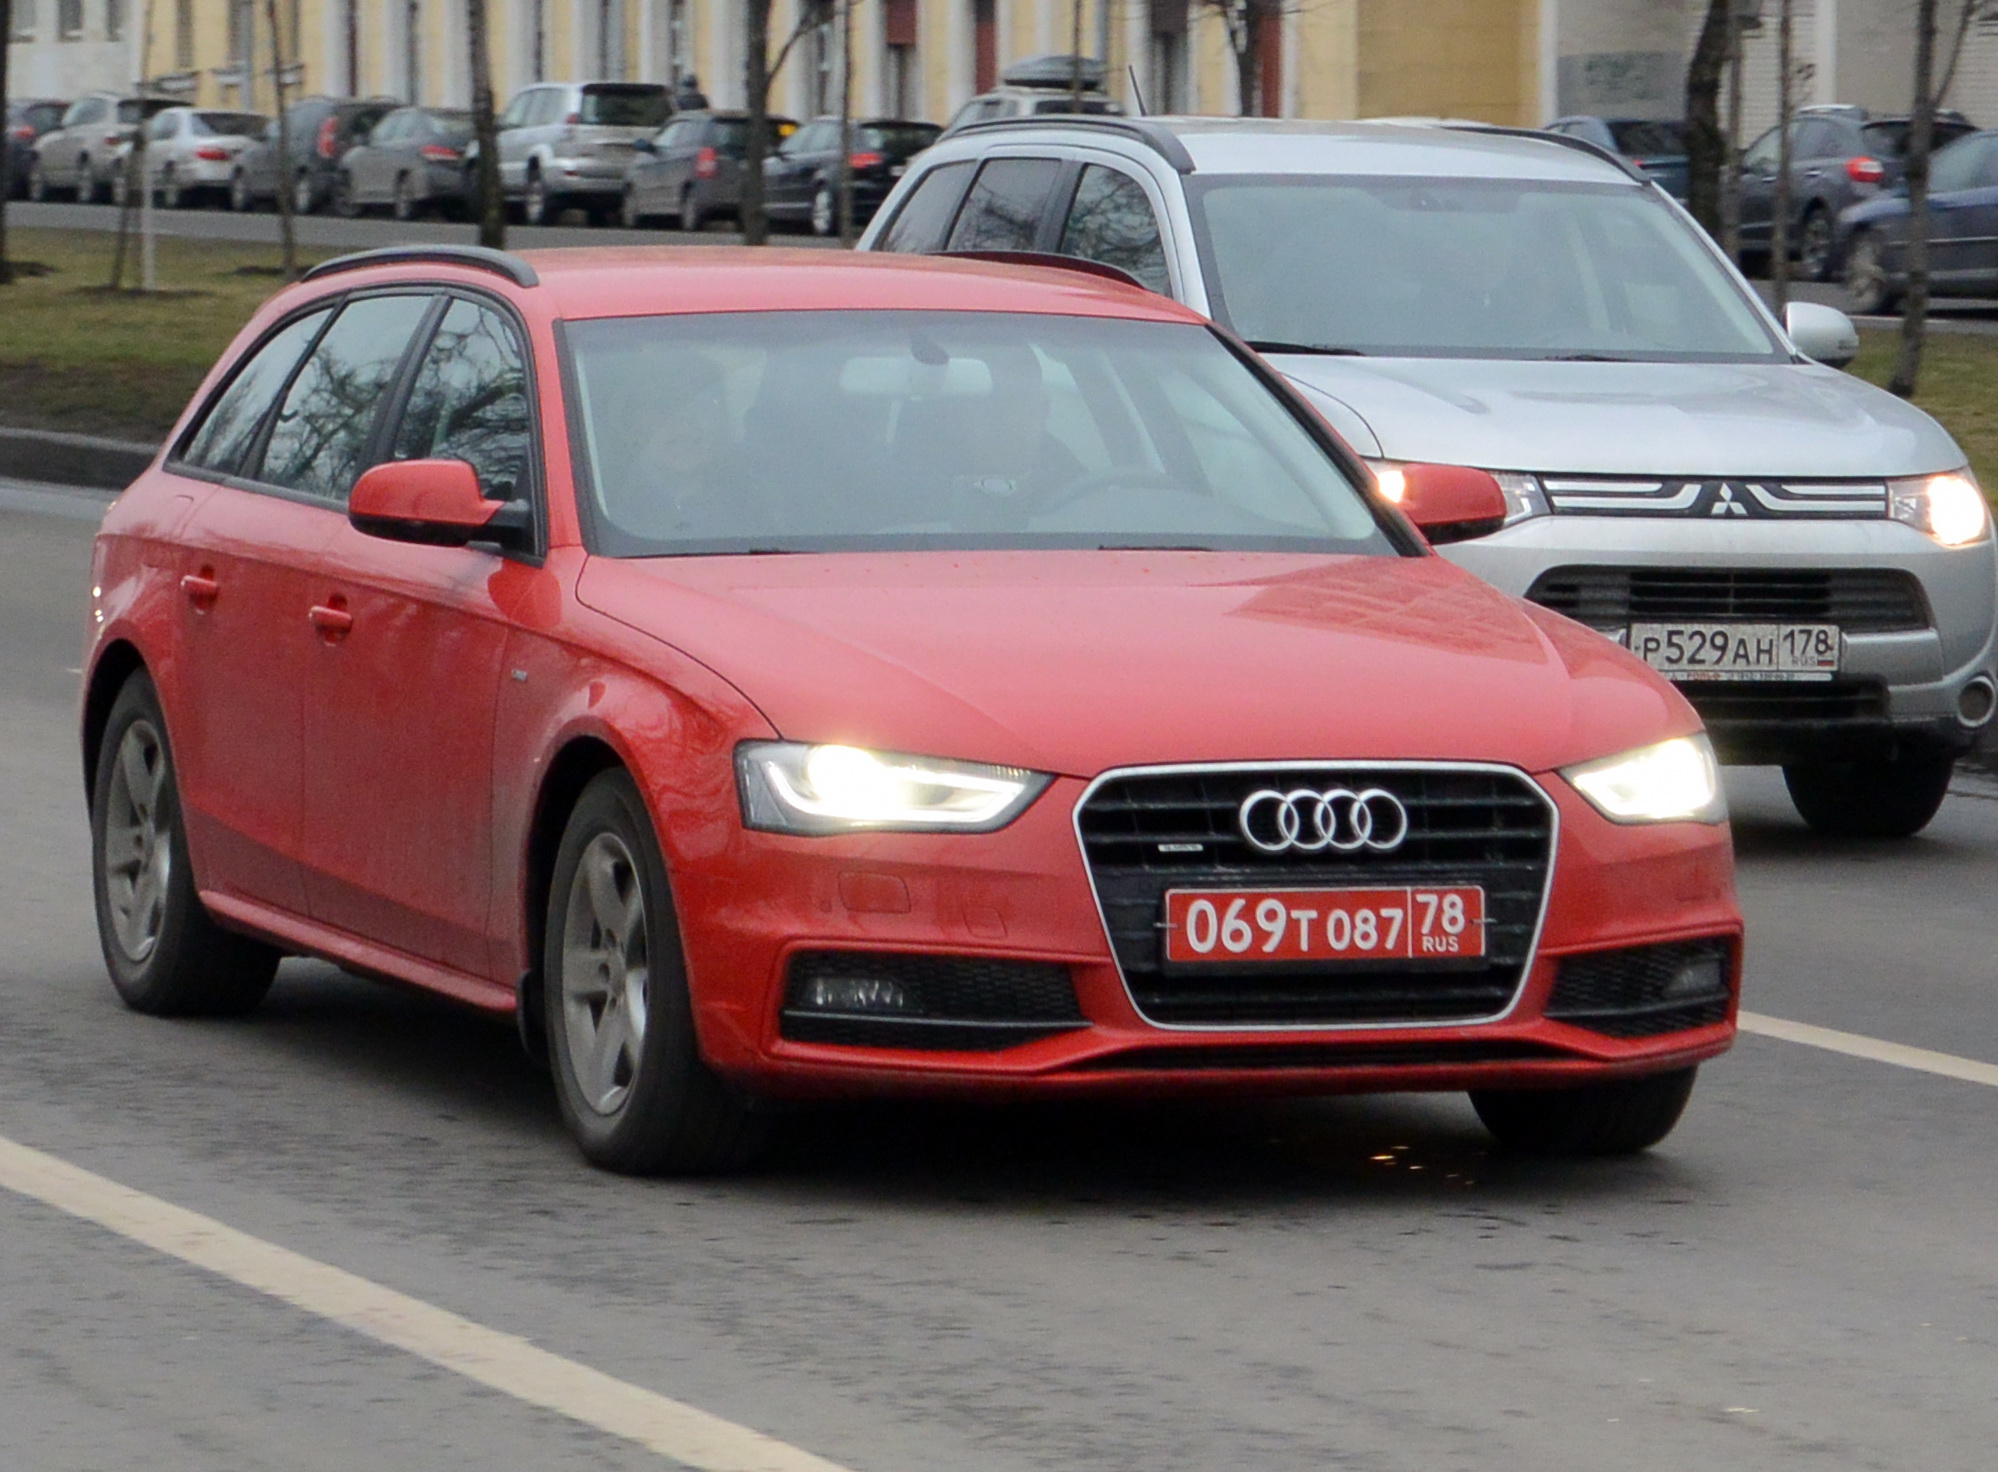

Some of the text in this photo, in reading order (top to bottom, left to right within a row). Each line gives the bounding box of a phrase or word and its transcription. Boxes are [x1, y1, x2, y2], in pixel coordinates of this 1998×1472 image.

[1643, 629, 1834, 666] P529AH 178
[1791, 655, 1816, 667] RUS
[1415, 893, 1466, 935] 78
[1422, 935, 1460, 953] RUS
